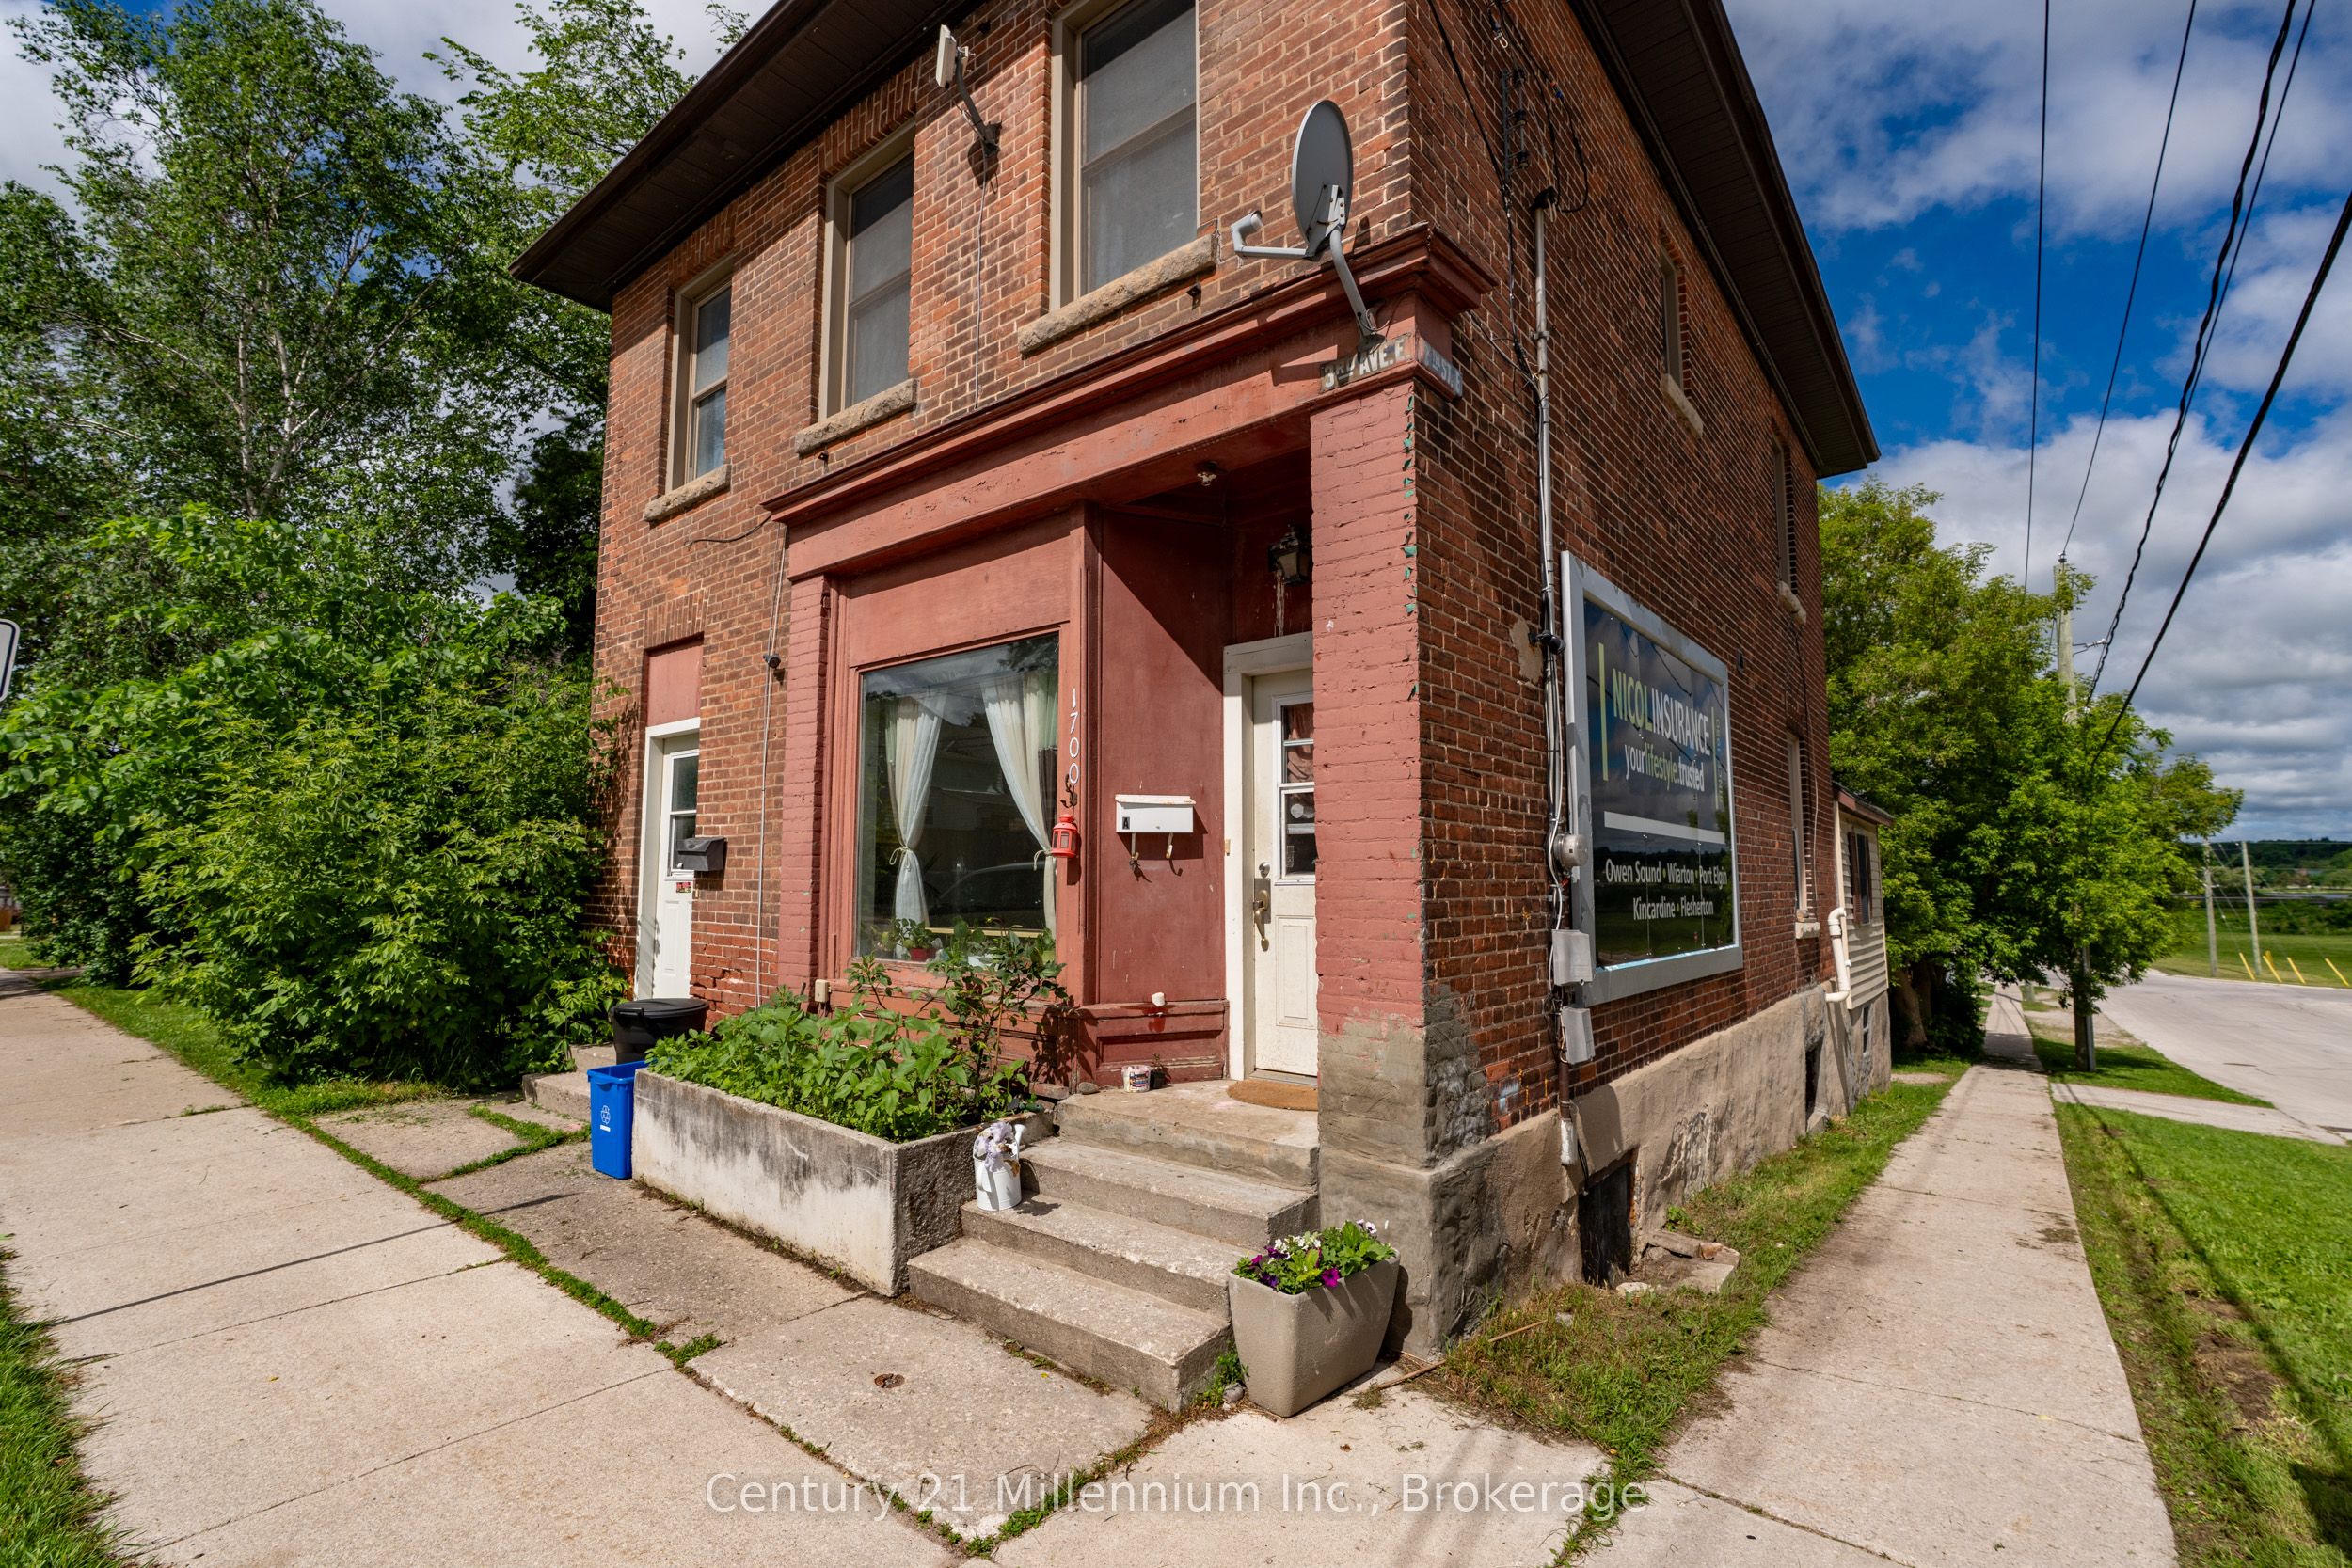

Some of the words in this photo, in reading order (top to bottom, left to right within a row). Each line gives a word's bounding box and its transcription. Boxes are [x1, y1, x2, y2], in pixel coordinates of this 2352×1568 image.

[1069, 687, 1079, 784] 1700
[1605, 858, 1633, 883] Owen
[1635, 860, 1661, 883] Sound
[1667, 862, 1694, 884] Wiarton
[1699, 865, 1712, 885] Port
[1714, 866, 1727, 890] Elgin
[1633, 895, 1675, 920] Kincardine
[1680, 895, 1713, 917] Flesherton
